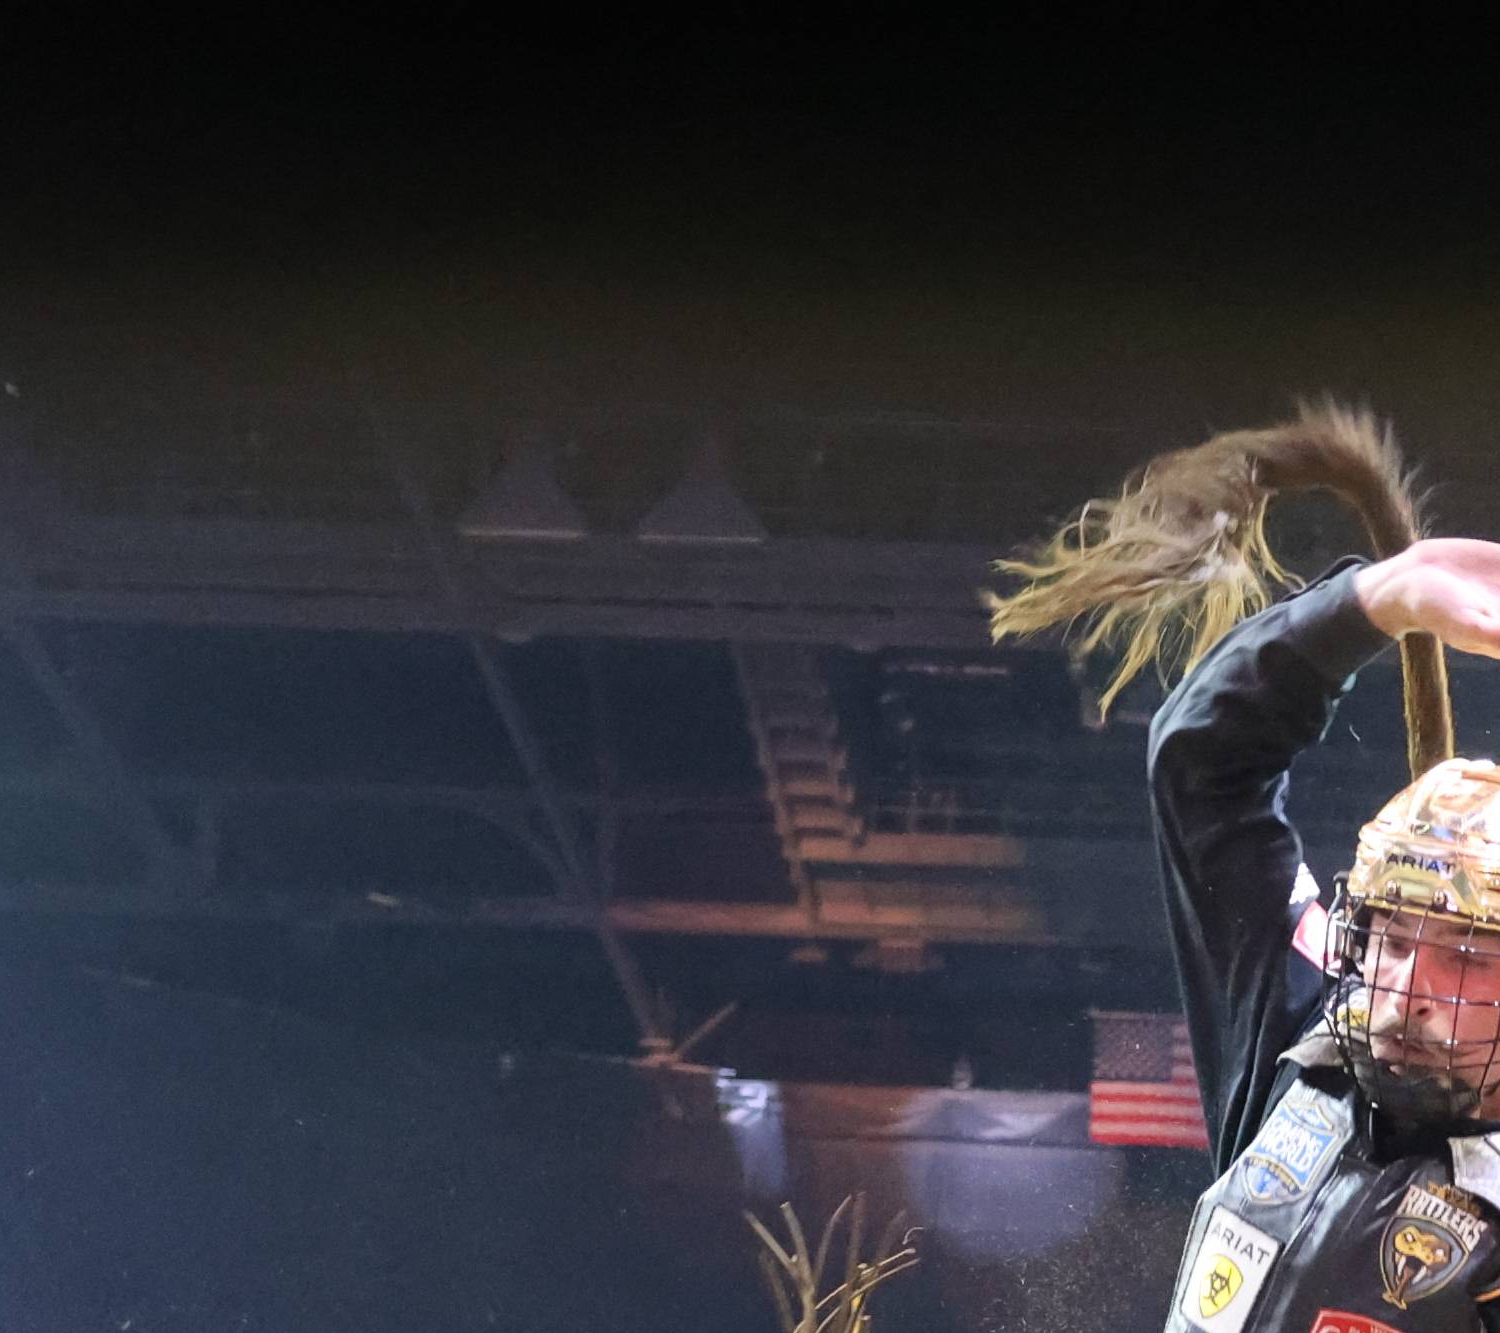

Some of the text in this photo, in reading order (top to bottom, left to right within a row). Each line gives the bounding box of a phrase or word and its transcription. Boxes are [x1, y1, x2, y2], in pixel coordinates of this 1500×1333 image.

[1386, 853, 1456, 875] ARIAT
[1396, 1184, 1489, 1252] RATTLERS
[1210, 1221, 1271, 1265] ARIAT
